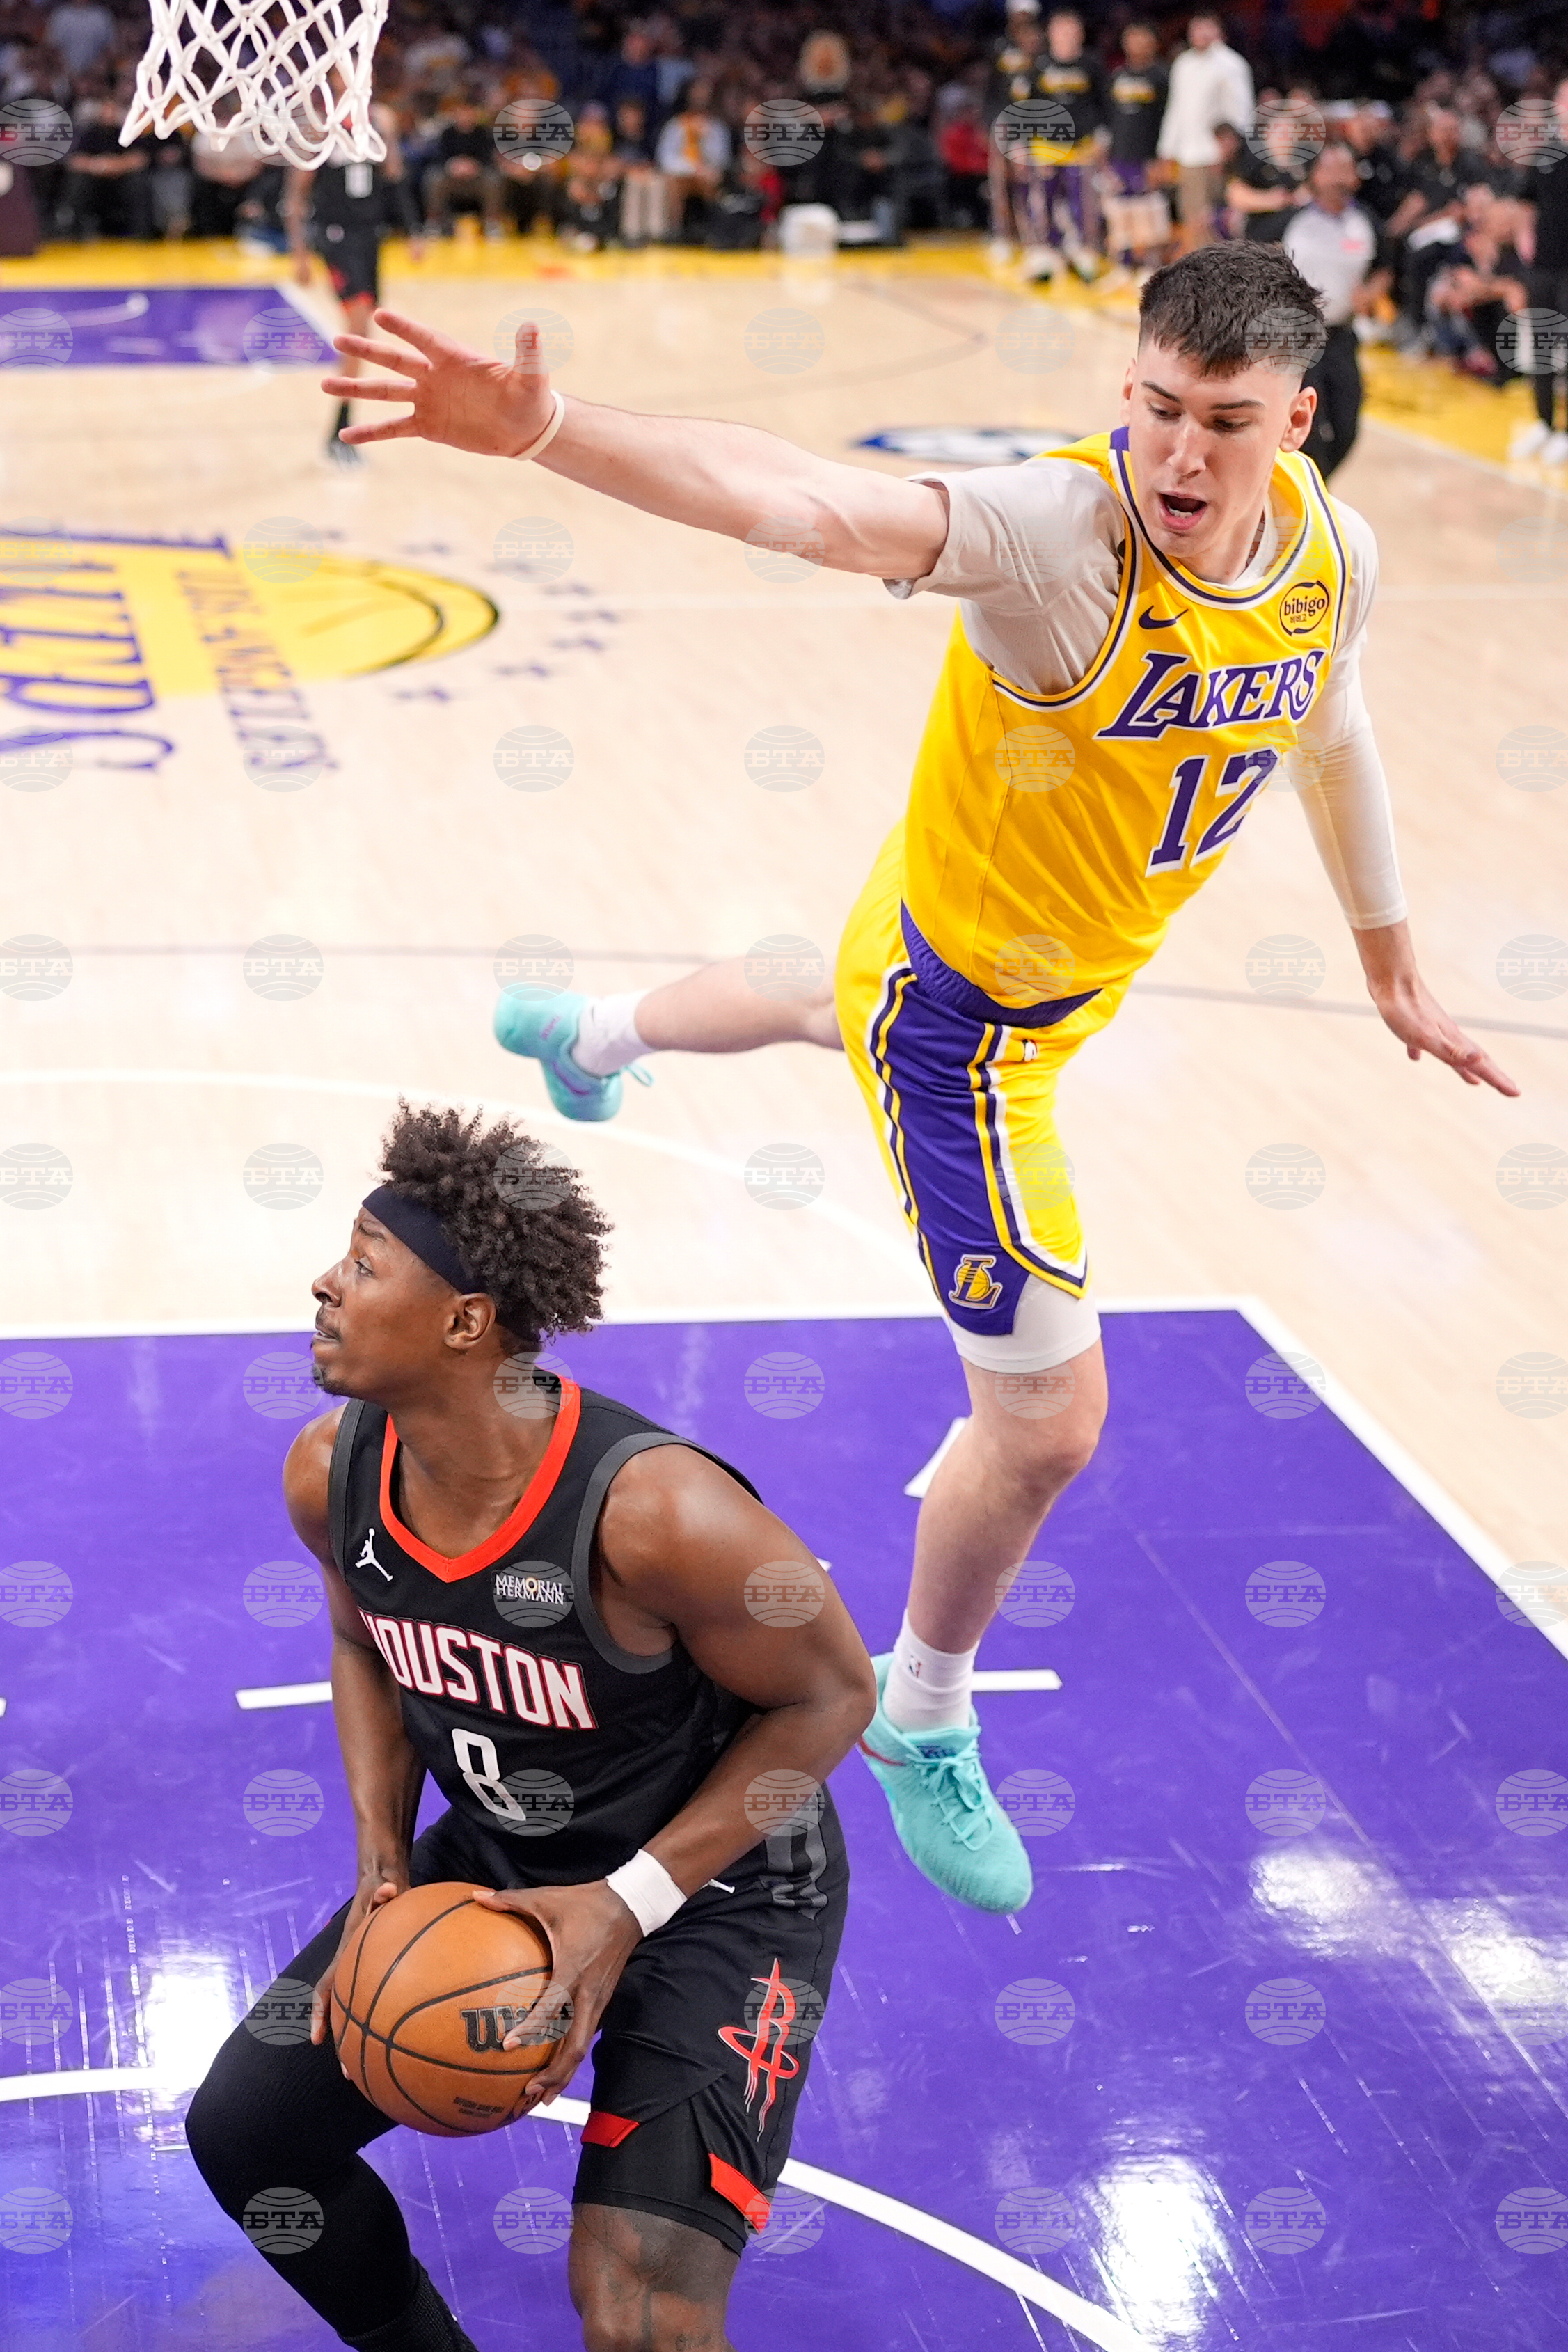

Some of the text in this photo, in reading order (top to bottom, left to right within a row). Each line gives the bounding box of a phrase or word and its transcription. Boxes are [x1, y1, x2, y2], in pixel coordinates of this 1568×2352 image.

[1284, 596, 1325, 617] bibigo
[1093, 650, 1329, 741] LAKERS
[1145, 746, 1281, 878] 12
[495, 1574, 564, 1595] MEMORIAL
[496, 1584, 564, 1606] HERMANN
[452, 1728, 526, 1821] 8
